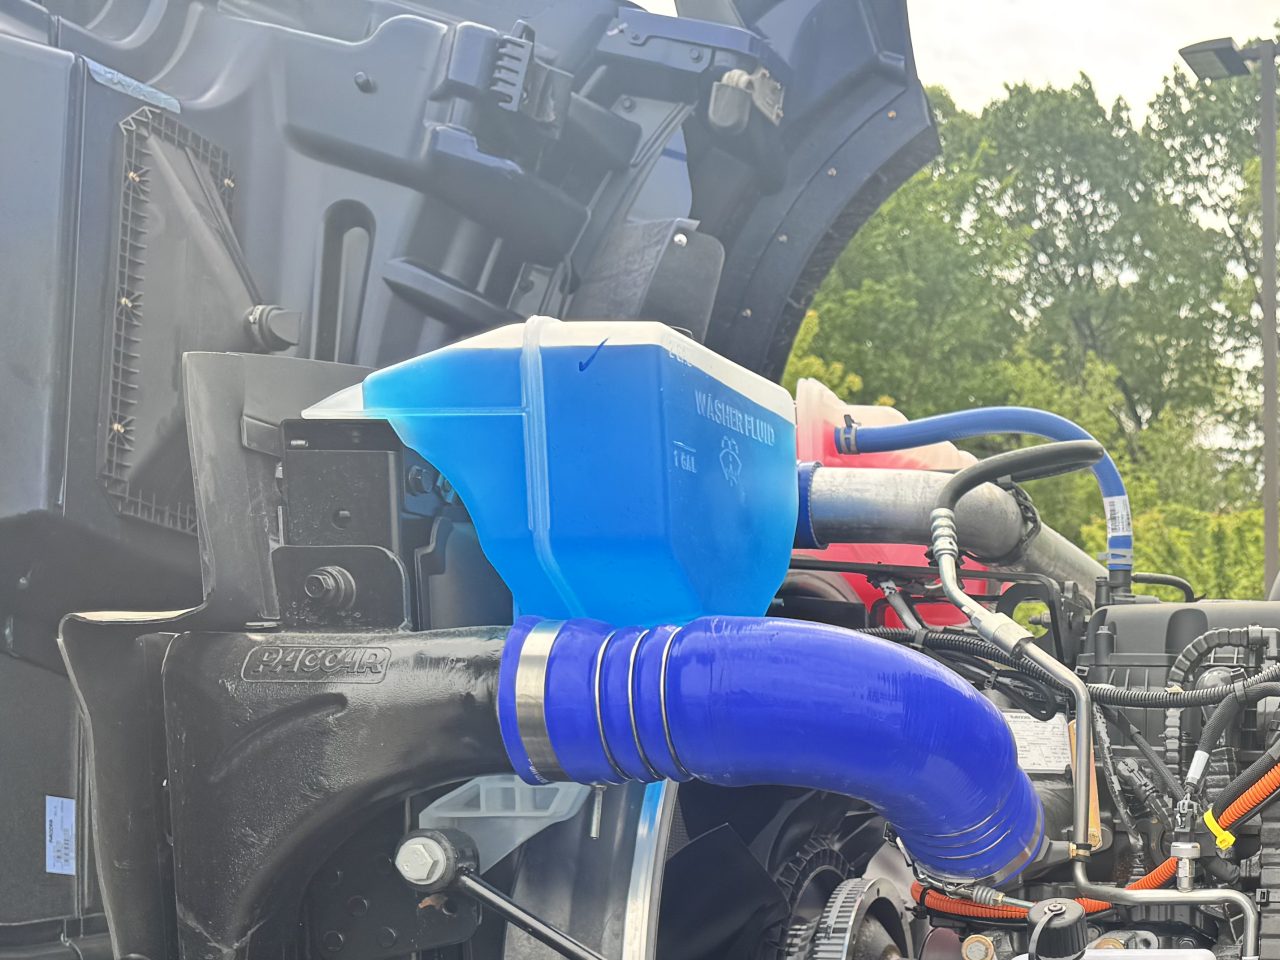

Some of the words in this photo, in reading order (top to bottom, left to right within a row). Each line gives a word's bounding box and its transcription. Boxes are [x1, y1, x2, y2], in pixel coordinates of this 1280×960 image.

[695, 389, 744, 434] WASHER
[745, 414, 776, 446] FLUID
[681, 452, 697, 473] GAL
[252, 647, 386, 674] PACCAR
